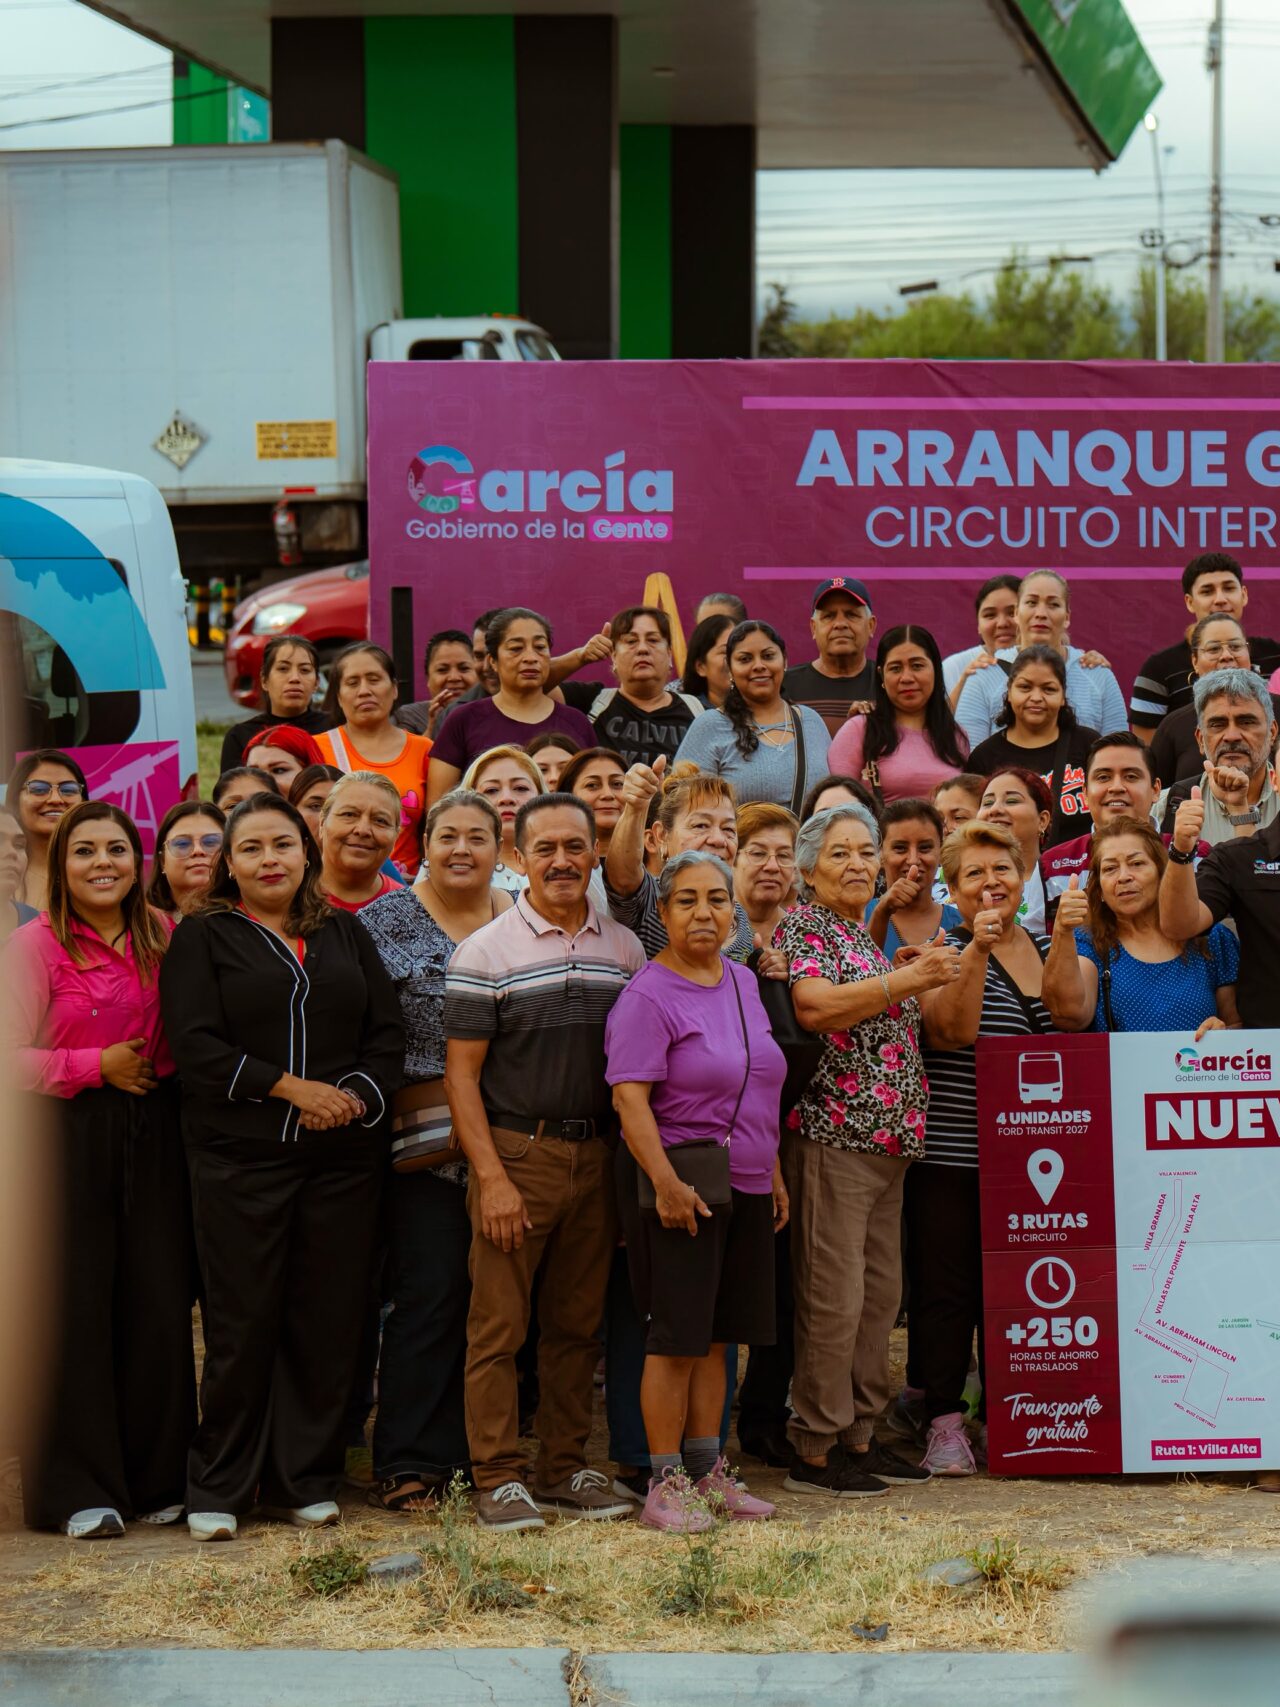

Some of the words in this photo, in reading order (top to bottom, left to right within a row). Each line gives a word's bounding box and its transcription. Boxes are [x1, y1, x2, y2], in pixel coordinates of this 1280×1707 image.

[796, 429, 1228, 495] ARRANQUE
[407, 445, 674, 513] García
[406, 518, 518, 539] Gobierno
[525, 518, 556, 539] de
[563, 518, 585, 539] la
[593, 519, 668, 539] Gente
[865, 506, 1120, 548] CIRCUITO
[1175, 1048, 1271, 1072] García
[1175, 1073, 1216, 1082] Gobierno
[1218, 1073, 1230, 1081] de
[1231, 1073, 1240, 1081] la
[1242, 1072, 1270, 1080] Gente
[996, 1112, 1007, 1125] 4
[1009, 1110, 1092, 1125] UNIDADES
[998, 1127, 1024, 1136] FORD
[1025, 1126, 1063, 1135] TRANSIT
[1066, 1125, 1089, 1134] 2027
[1008, 1214, 1019, 1230] 3
[1023, 1212, 1089, 1230] RUTAS
[1144, 1231, 1155, 1251] VILLA
[1150, 1193, 1167, 1230] GRANADA
[1183, 1213, 1195, 1234] VILLA
[1190, 1193, 1201, 1214] ALTA
[1008, 1234, 1020, 1243] EN
[1022, 1233, 1067, 1242] CIRCUITO
[1155, 1289, 1169, 1315] VILLAS
[1164, 1276, 1174, 1290] DEL
[1169, 1239, 1187, 1276] PONIENTE
[1005, 1316, 1099, 1347] +250
[1156, 1319, 1168, 1329] AV.
[1169, 1325, 1206, 1347] ABRAHAM
[1206, 1343, 1237, 1363] LINCOLN
[1010, 1352, 1042, 1361] HORAS
[1044, 1351, 1056, 1360] DE
[1059, 1351, 1099, 1360] AHORRO
[1143, 1333, 1171, 1351] ABRAHAM
[1170, 1348, 1193, 1364] LINCOLN
[1010, 1363, 1022, 1372] EN
[1025, 1362, 1079, 1372] TRASLADOS
[1003, 1393, 1103, 1424] Transporte
[1026, 1419, 1089, 1447] gratuito
[1155, 1446, 1186, 1457] Ruta
[1188, 1445, 1197, 1455] 1:
[1199, 1444, 1228, 1455] Villa
[1230, 1443, 1258, 1455] Alta
